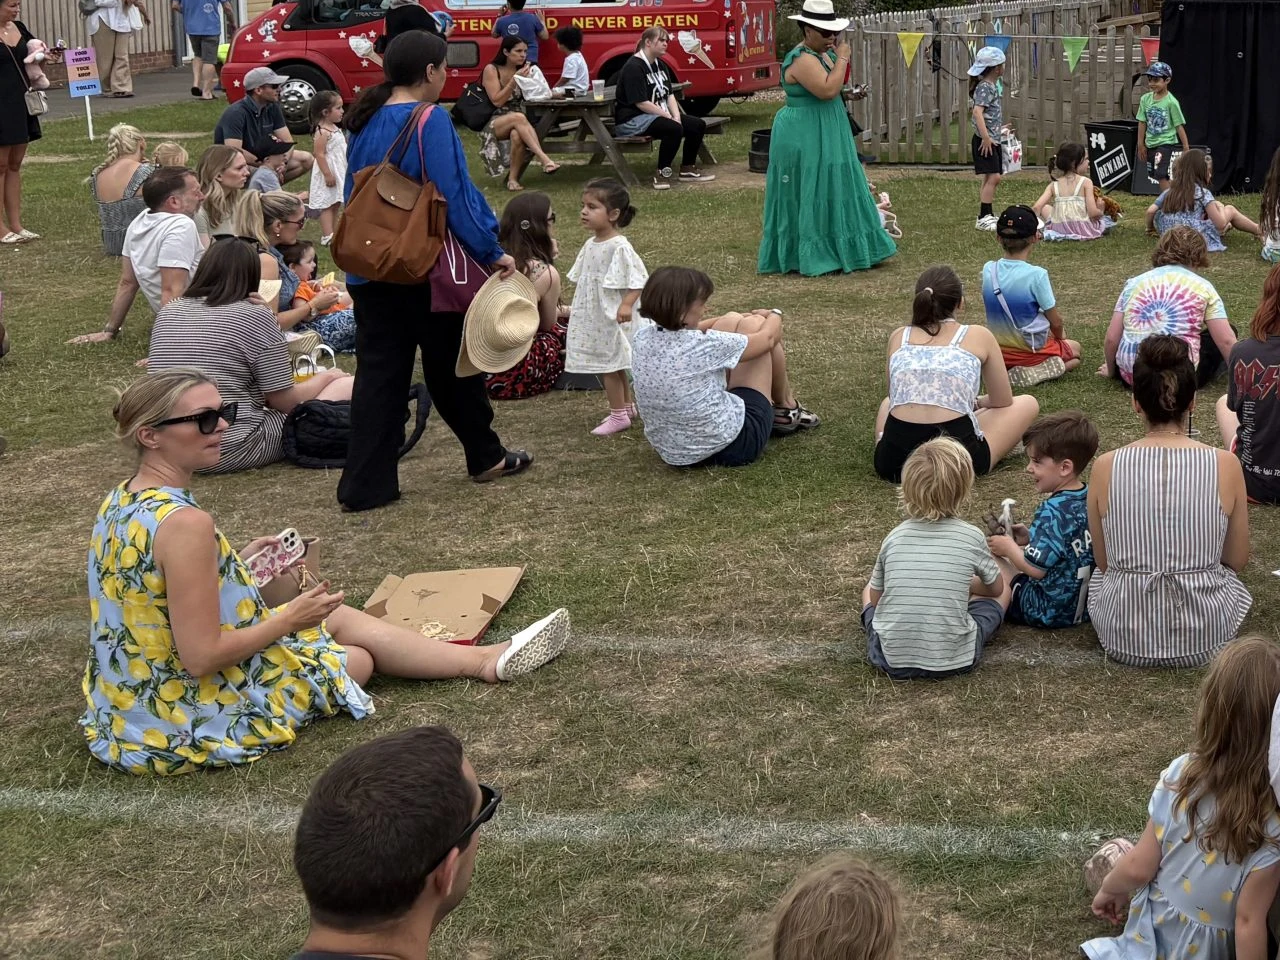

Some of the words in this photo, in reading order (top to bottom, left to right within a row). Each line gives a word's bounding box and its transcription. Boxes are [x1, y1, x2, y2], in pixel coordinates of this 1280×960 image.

[572, 16, 627, 29] NEVER
[632, 14, 699, 28] BEATEN
[1098, 152, 1127, 180] BEWARE
